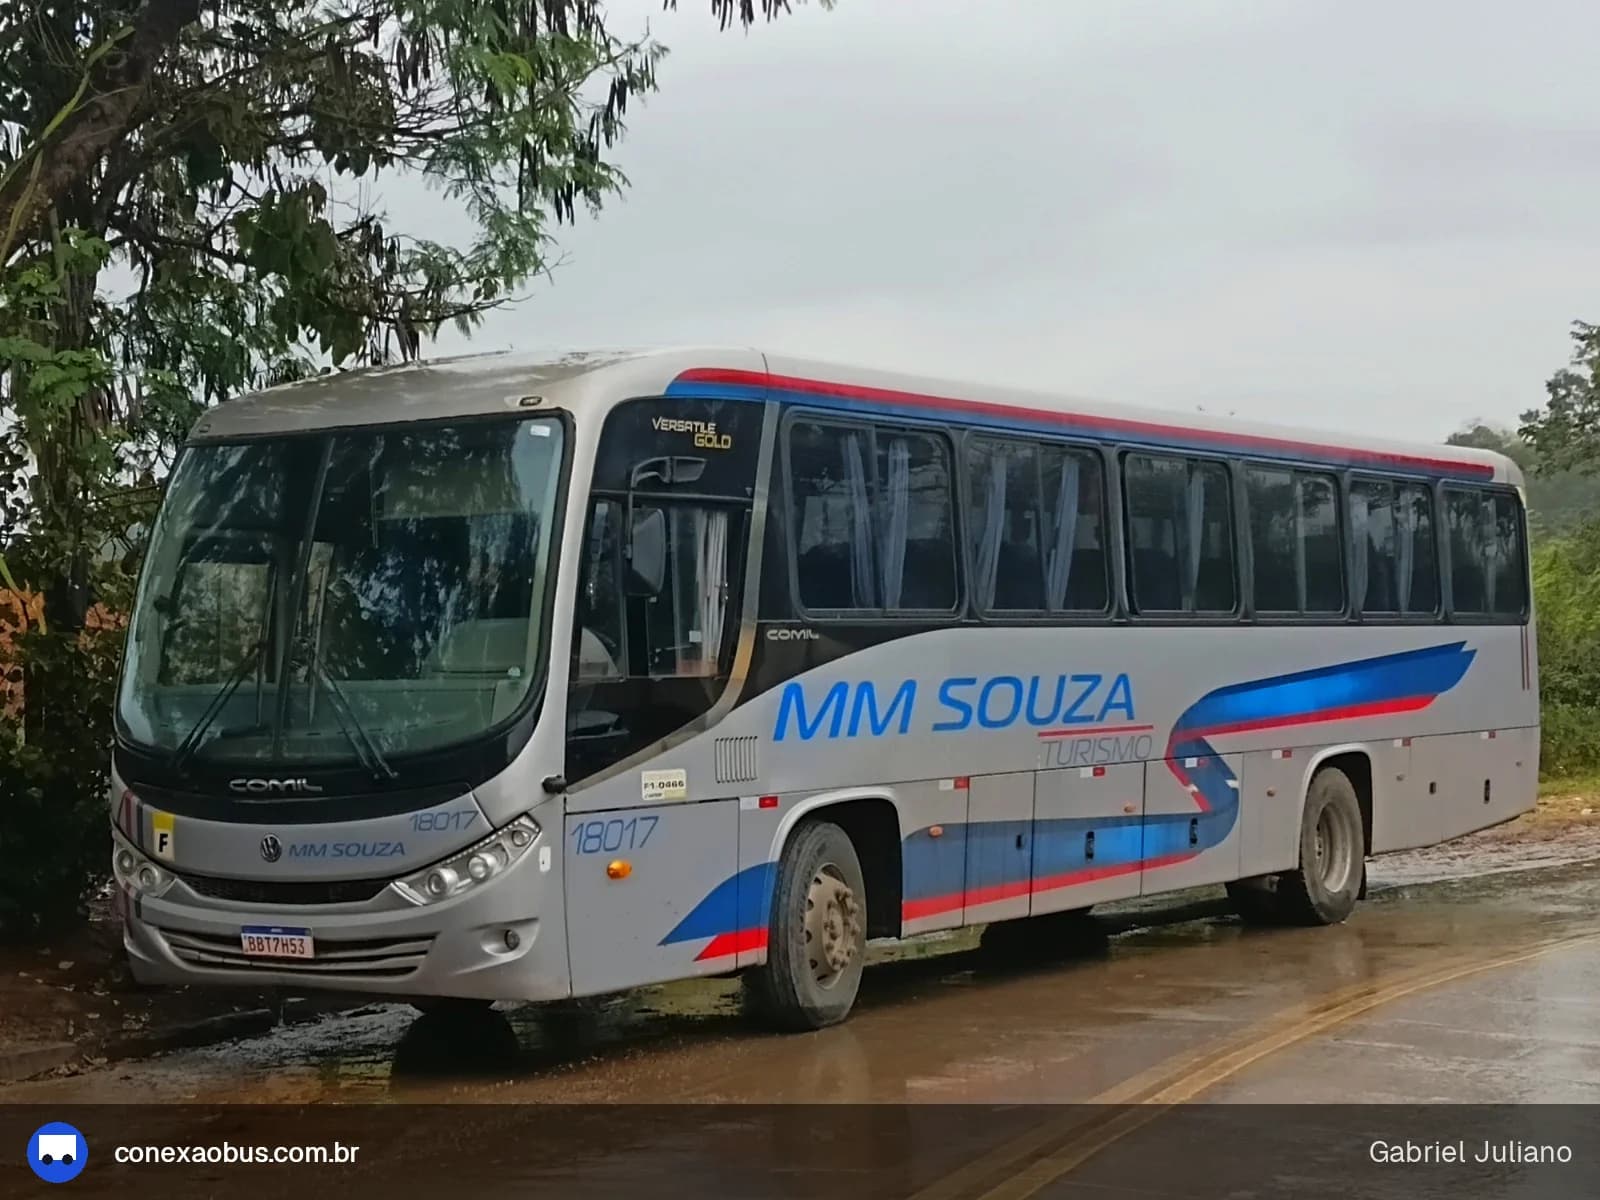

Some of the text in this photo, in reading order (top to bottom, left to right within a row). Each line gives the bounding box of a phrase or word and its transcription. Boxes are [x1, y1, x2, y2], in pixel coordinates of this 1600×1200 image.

[652, 417, 716, 434] VERSATILE
[694, 433, 731, 449] GOLD
[766, 629, 820, 641] COMIL
[773, 673, 1136, 742] MM SOUZA
[1042, 735, 1153, 768] TURISMO
[229, 778, 323, 793] COMIL
[409, 811, 478, 832] 18017
[158, 833, 169, 853] F
[571, 816, 660, 855] 18017
[288, 841, 406, 858] MM SOUZA
[247, 935, 305, 955] BBT7H53
